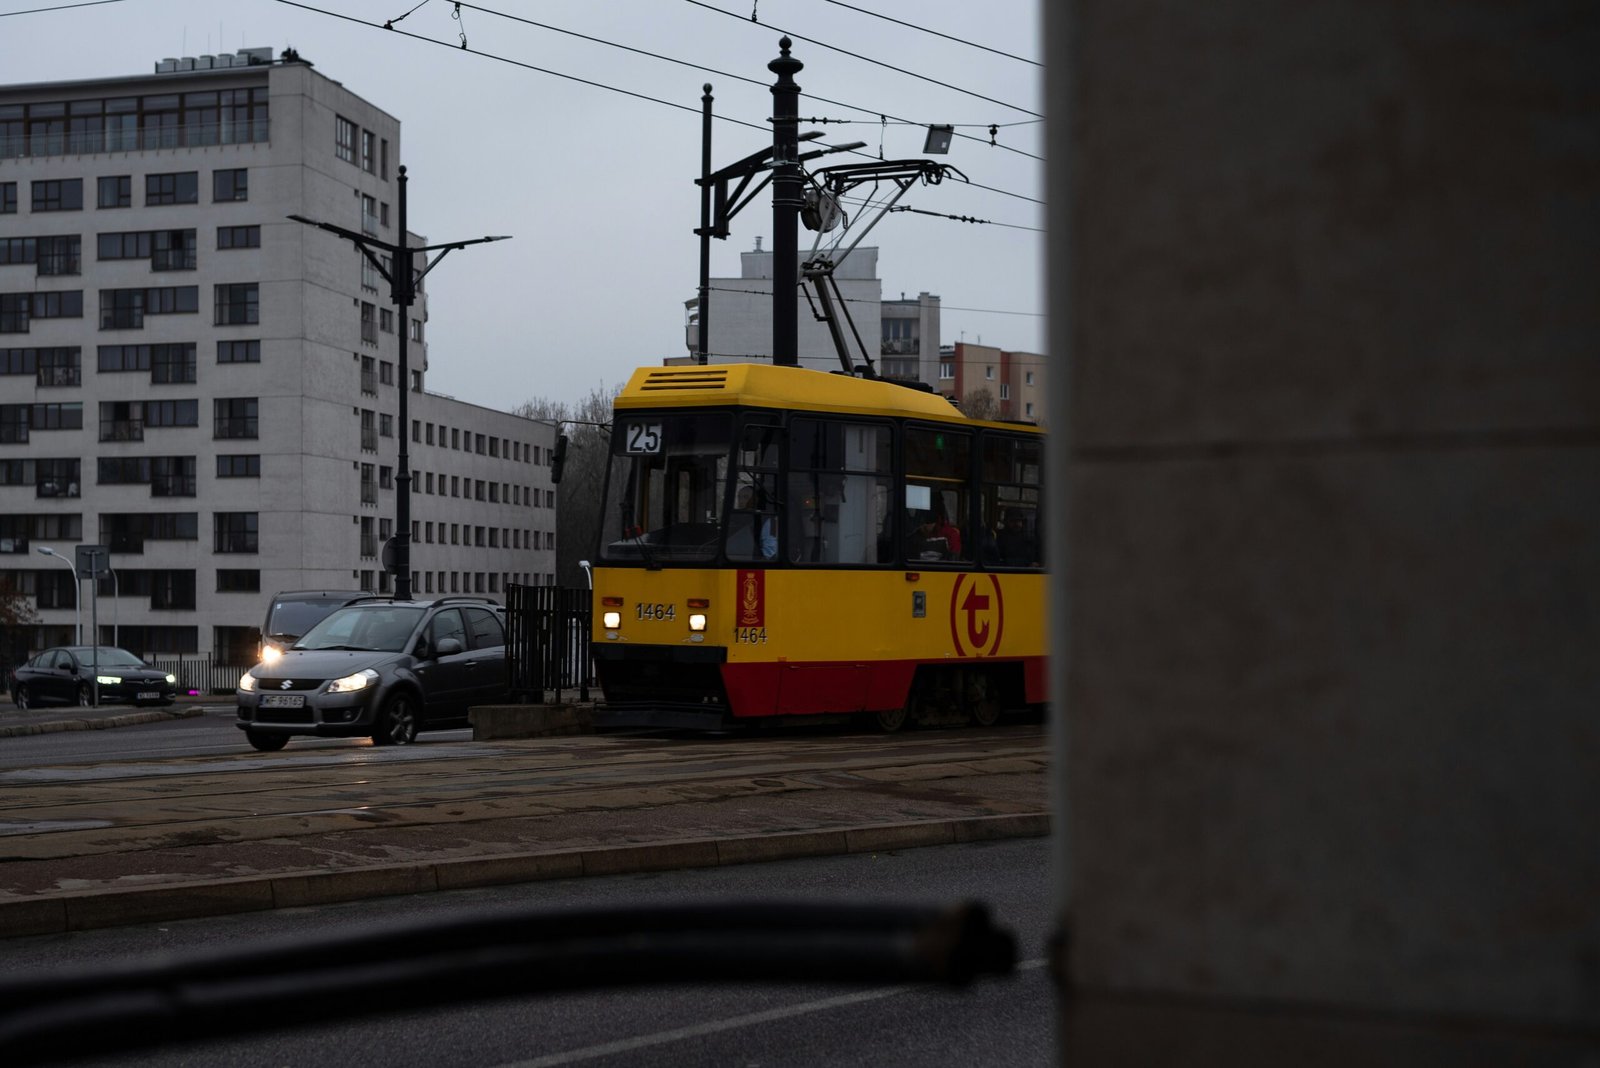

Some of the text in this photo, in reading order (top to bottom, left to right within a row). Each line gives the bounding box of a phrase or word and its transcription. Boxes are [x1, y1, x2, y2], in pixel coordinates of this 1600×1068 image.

[629, 423, 659, 452] 25
[636, 603, 676, 621] 1464
[734, 628, 768, 645] 1464
